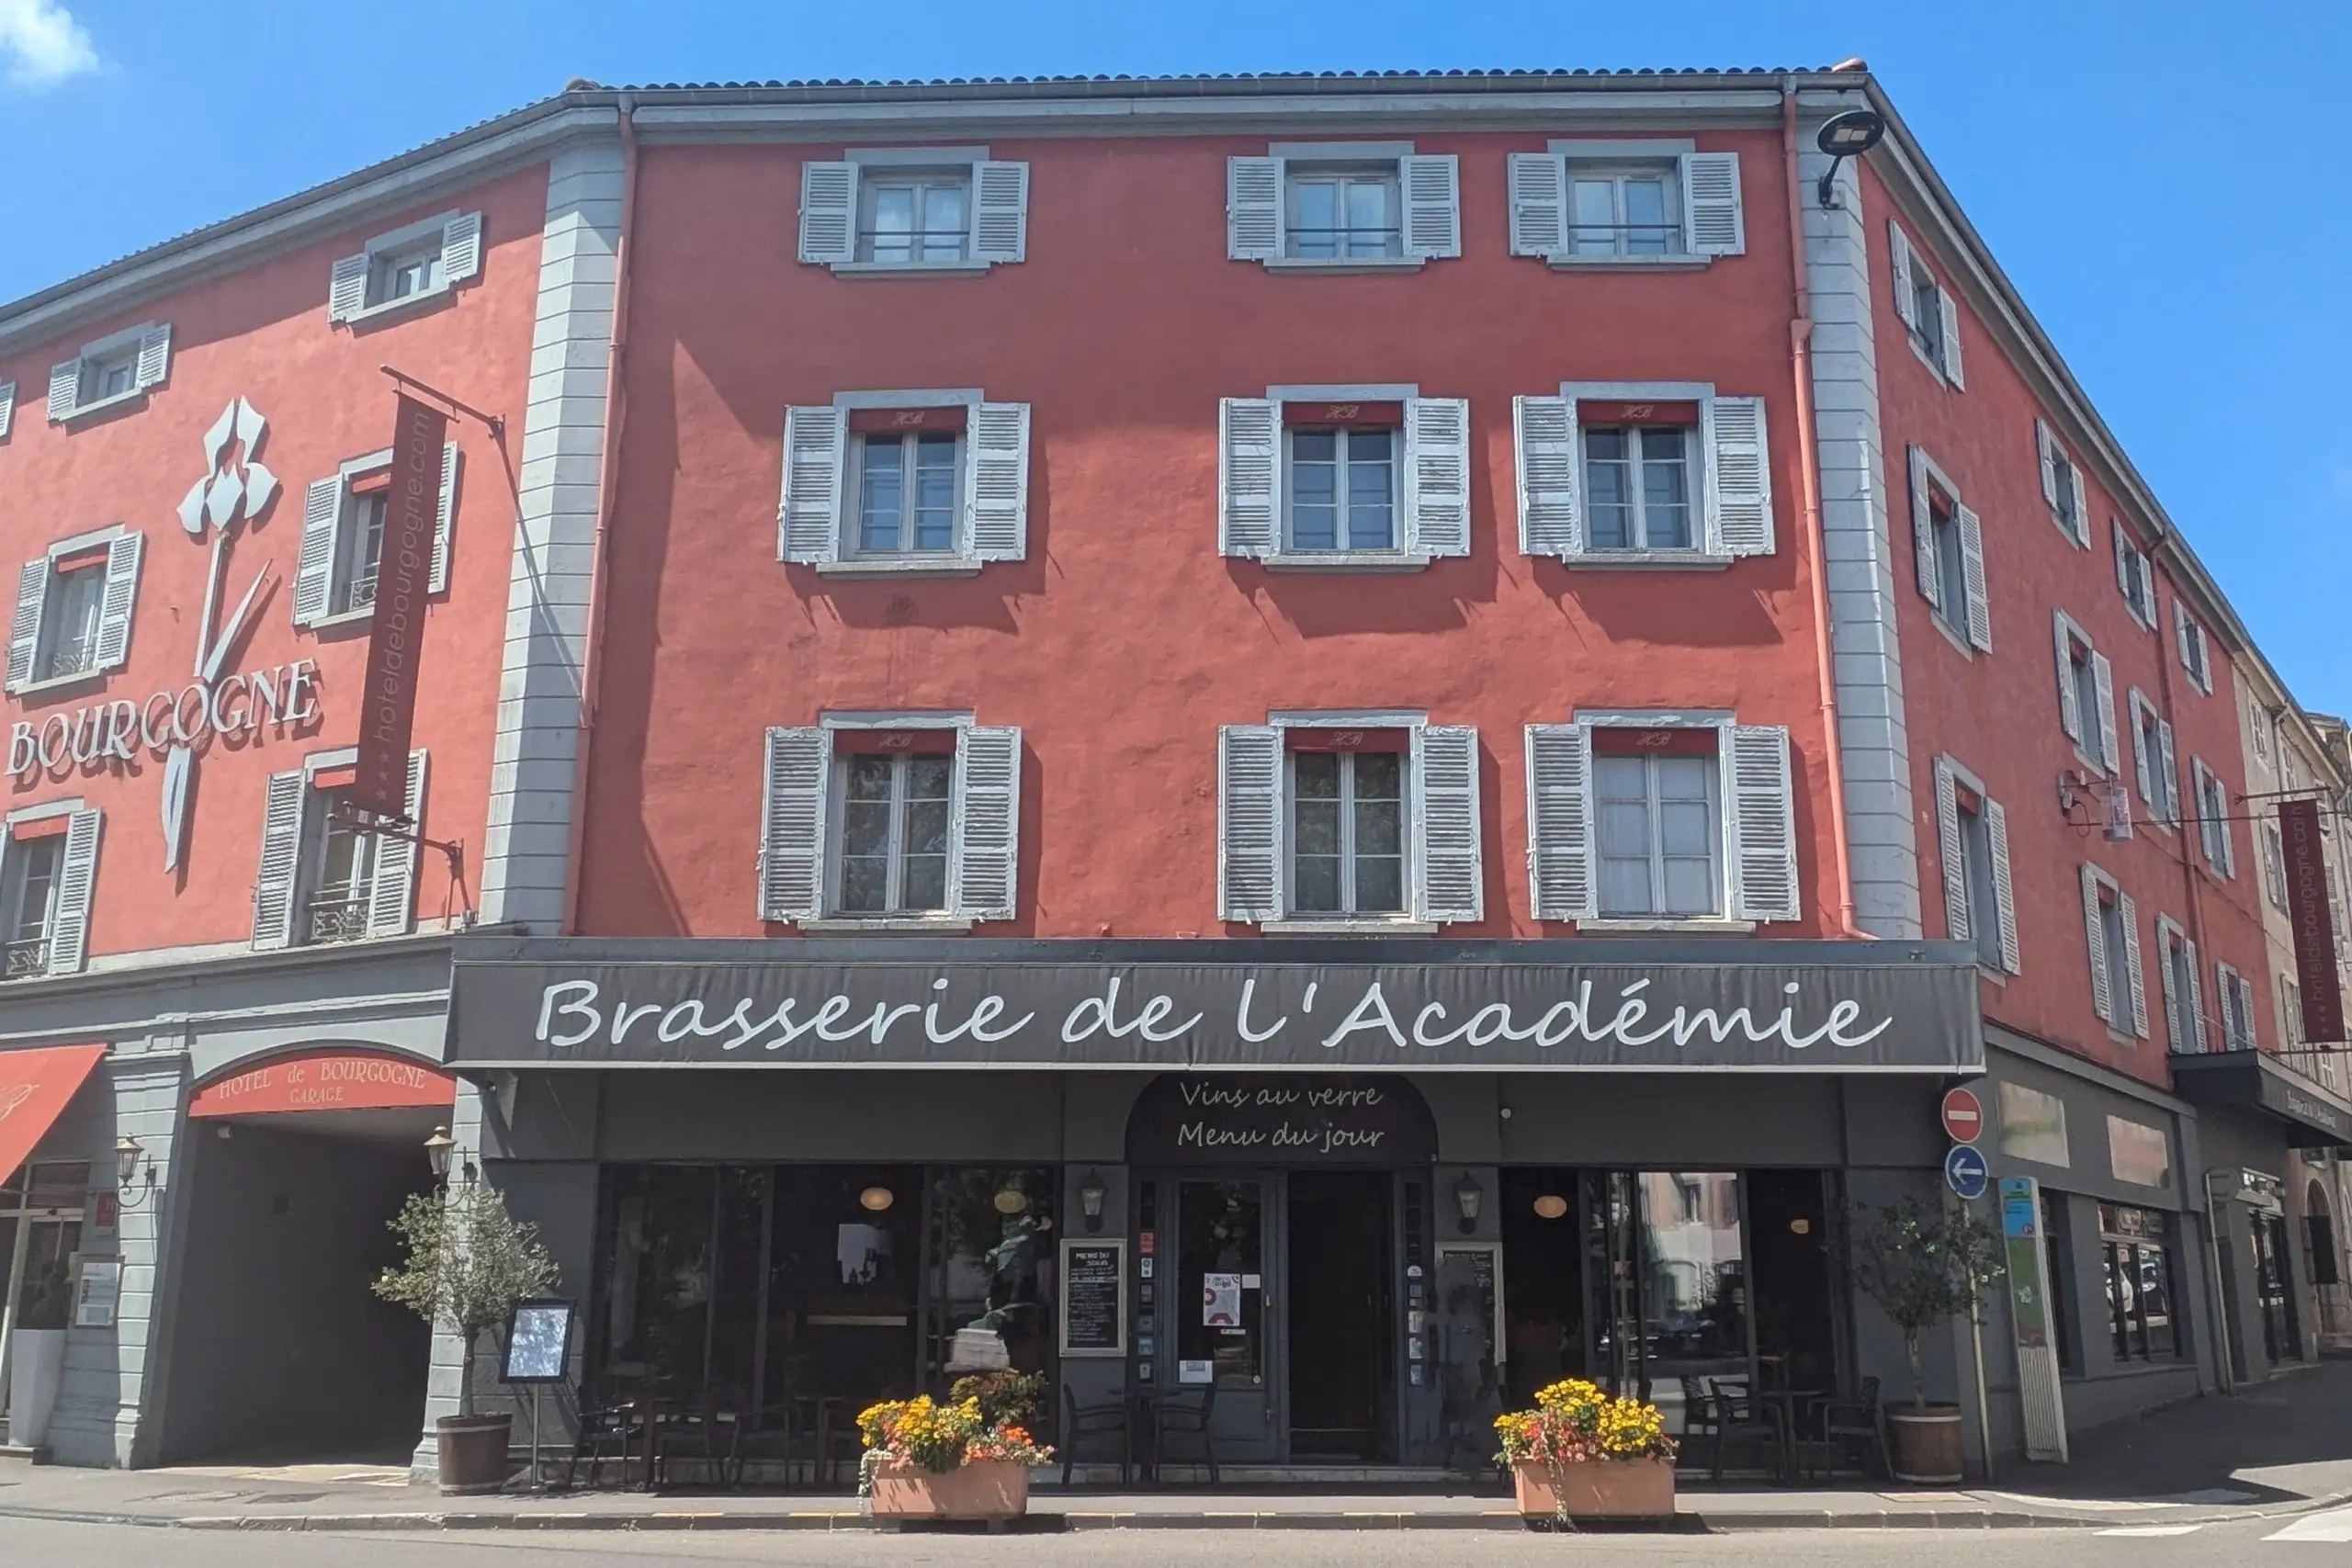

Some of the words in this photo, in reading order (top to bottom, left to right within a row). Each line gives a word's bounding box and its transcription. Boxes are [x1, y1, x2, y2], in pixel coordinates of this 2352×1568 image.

[375, 412, 430, 743] hoteldebourgogne.com
[5, 658, 318, 776] BOURGOGNE
[535, 978, 1035, 1050] Brasserie
[1060, 976, 1204, 1043] de
[288, 1066, 305, 1084] de
[321, 1061, 427, 1089] BOURGOGNE
[290, 1087, 345, 1105] GARAGE
[1180, 1082, 1250, 1108] Vins
[1256, 1089, 1301, 1106] au
[1307, 1088, 1384, 1107] verre
[1177, 1122, 1266, 1146] Menu
[1272, 1122, 1319, 1146] du
[1319, 1122, 1385, 1154] jour
